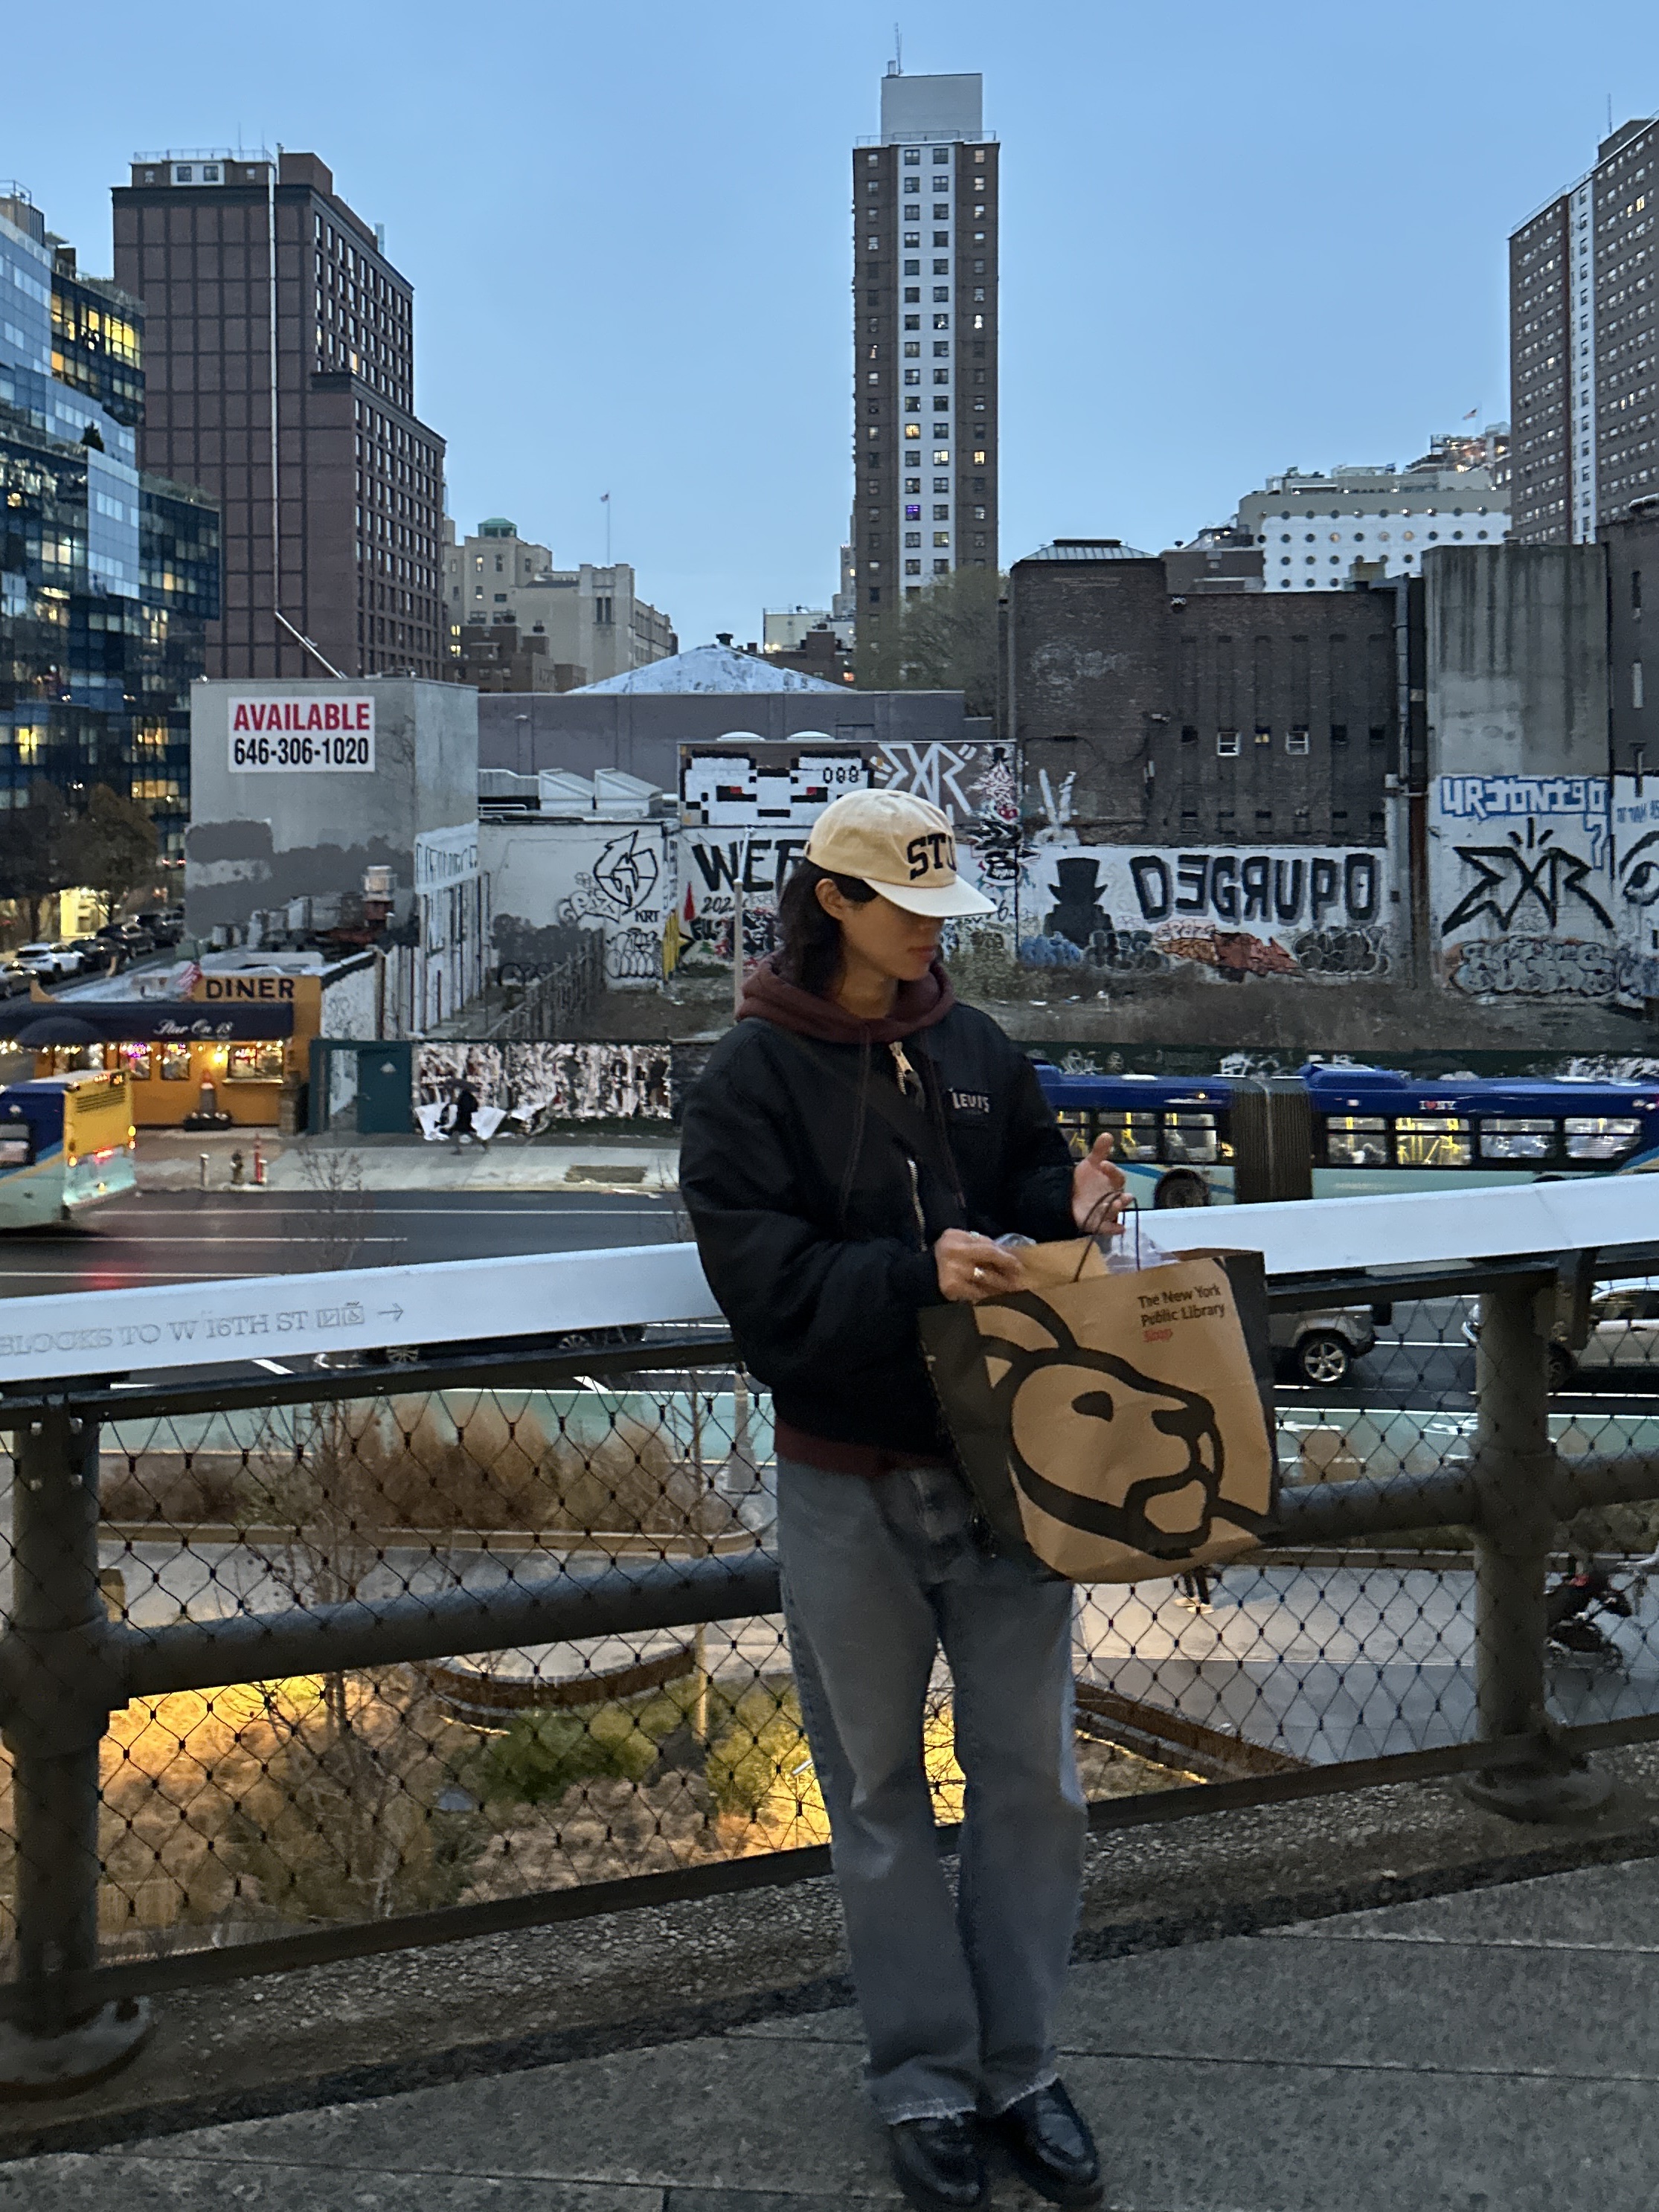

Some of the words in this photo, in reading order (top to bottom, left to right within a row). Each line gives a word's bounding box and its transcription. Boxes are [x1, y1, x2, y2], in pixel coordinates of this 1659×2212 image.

[234, 703, 370, 731] AVAILABLE
[234, 737, 368, 765] 646-306-1020
[205, 978, 295, 1000] DINER
[1137, 1295, 1160, 1308] The
[1161, 1290, 1193, 1303] New
[1194, 1283, 1221, 1298] York
[1140, 1309, 1178, 1327] Public
[1181, 1303, 1225, 1320] Library
[117, 1324, 161, 1346] TO
[167, 1320, 199, 1340] W
[202, 1314, 269, 1339] 16TH
[276, 1311, 308, 1331] ST
